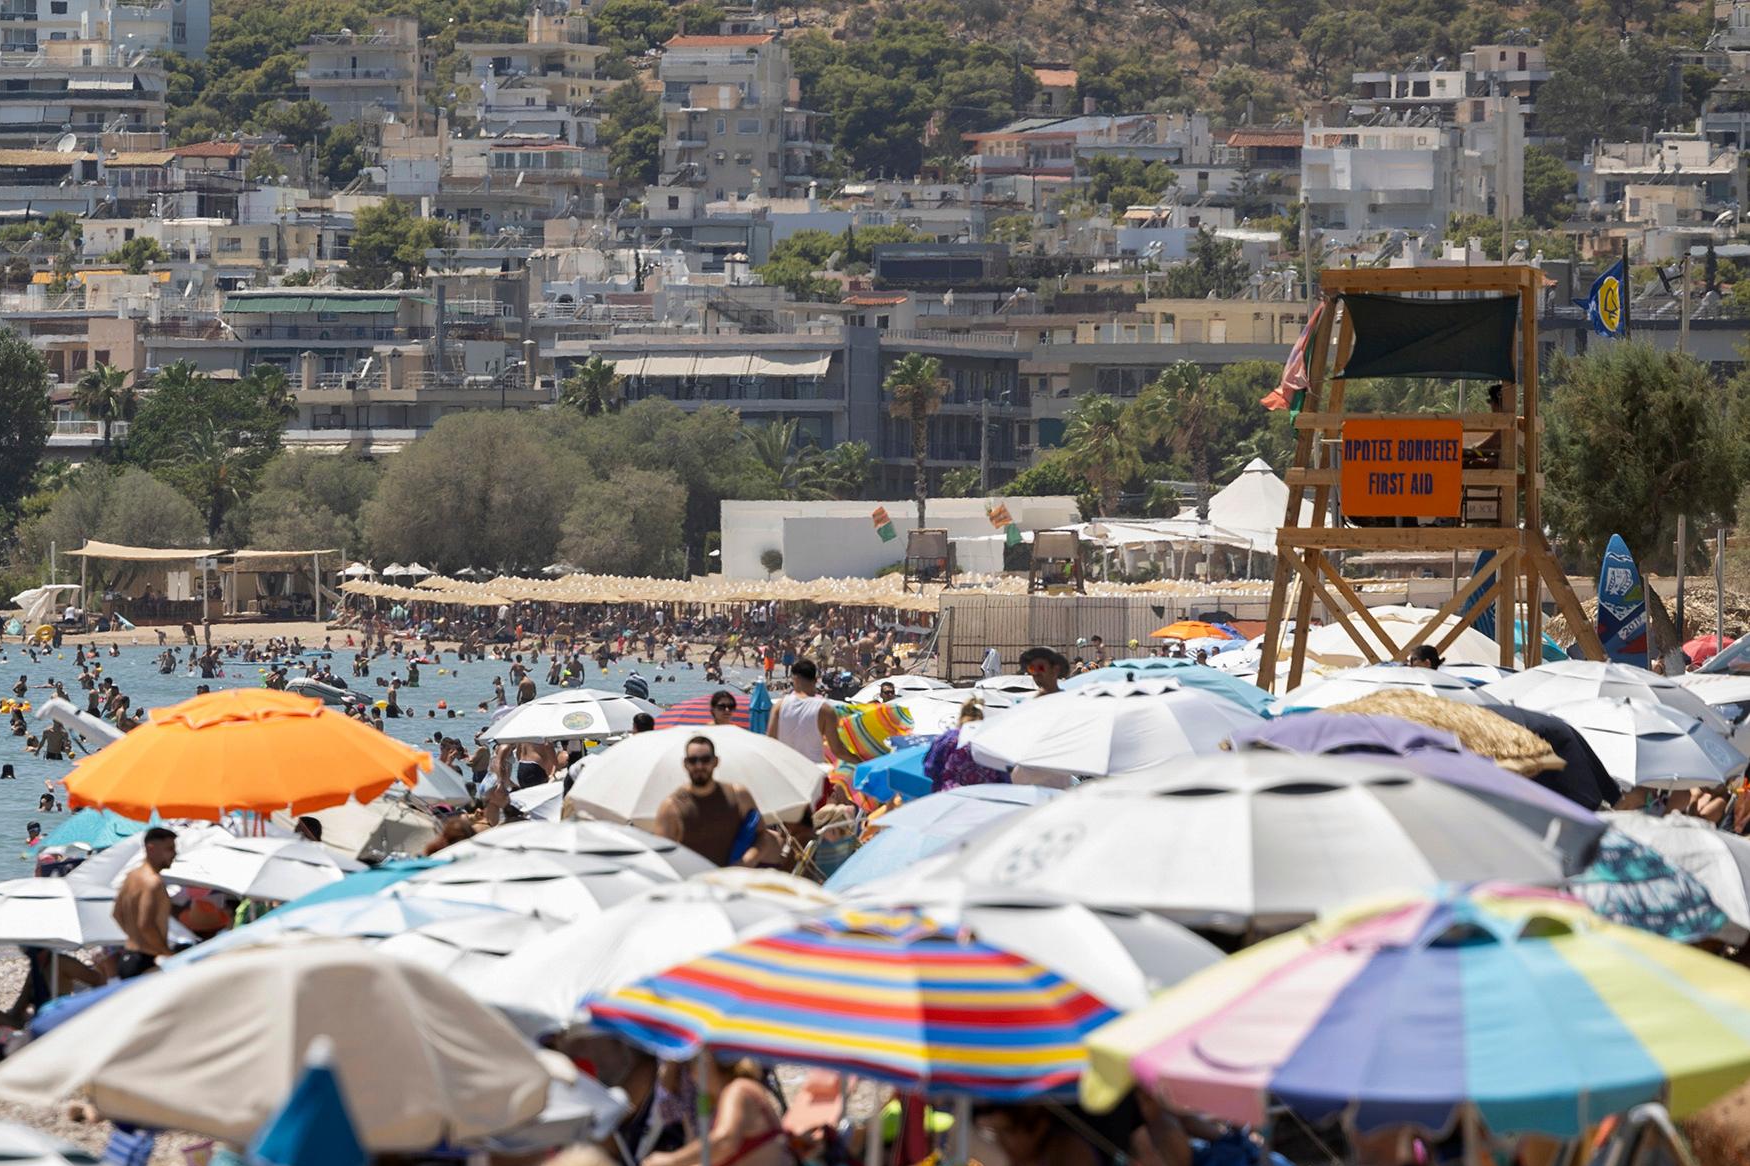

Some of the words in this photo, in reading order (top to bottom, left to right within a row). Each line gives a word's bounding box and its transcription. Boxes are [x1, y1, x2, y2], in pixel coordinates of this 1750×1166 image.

[1344, 439, 1393, 461] ΠΡΩΤΕΣ
[1368, 473, 1406, 495] FIRST
[1410, 473, 1434, 495] AID
